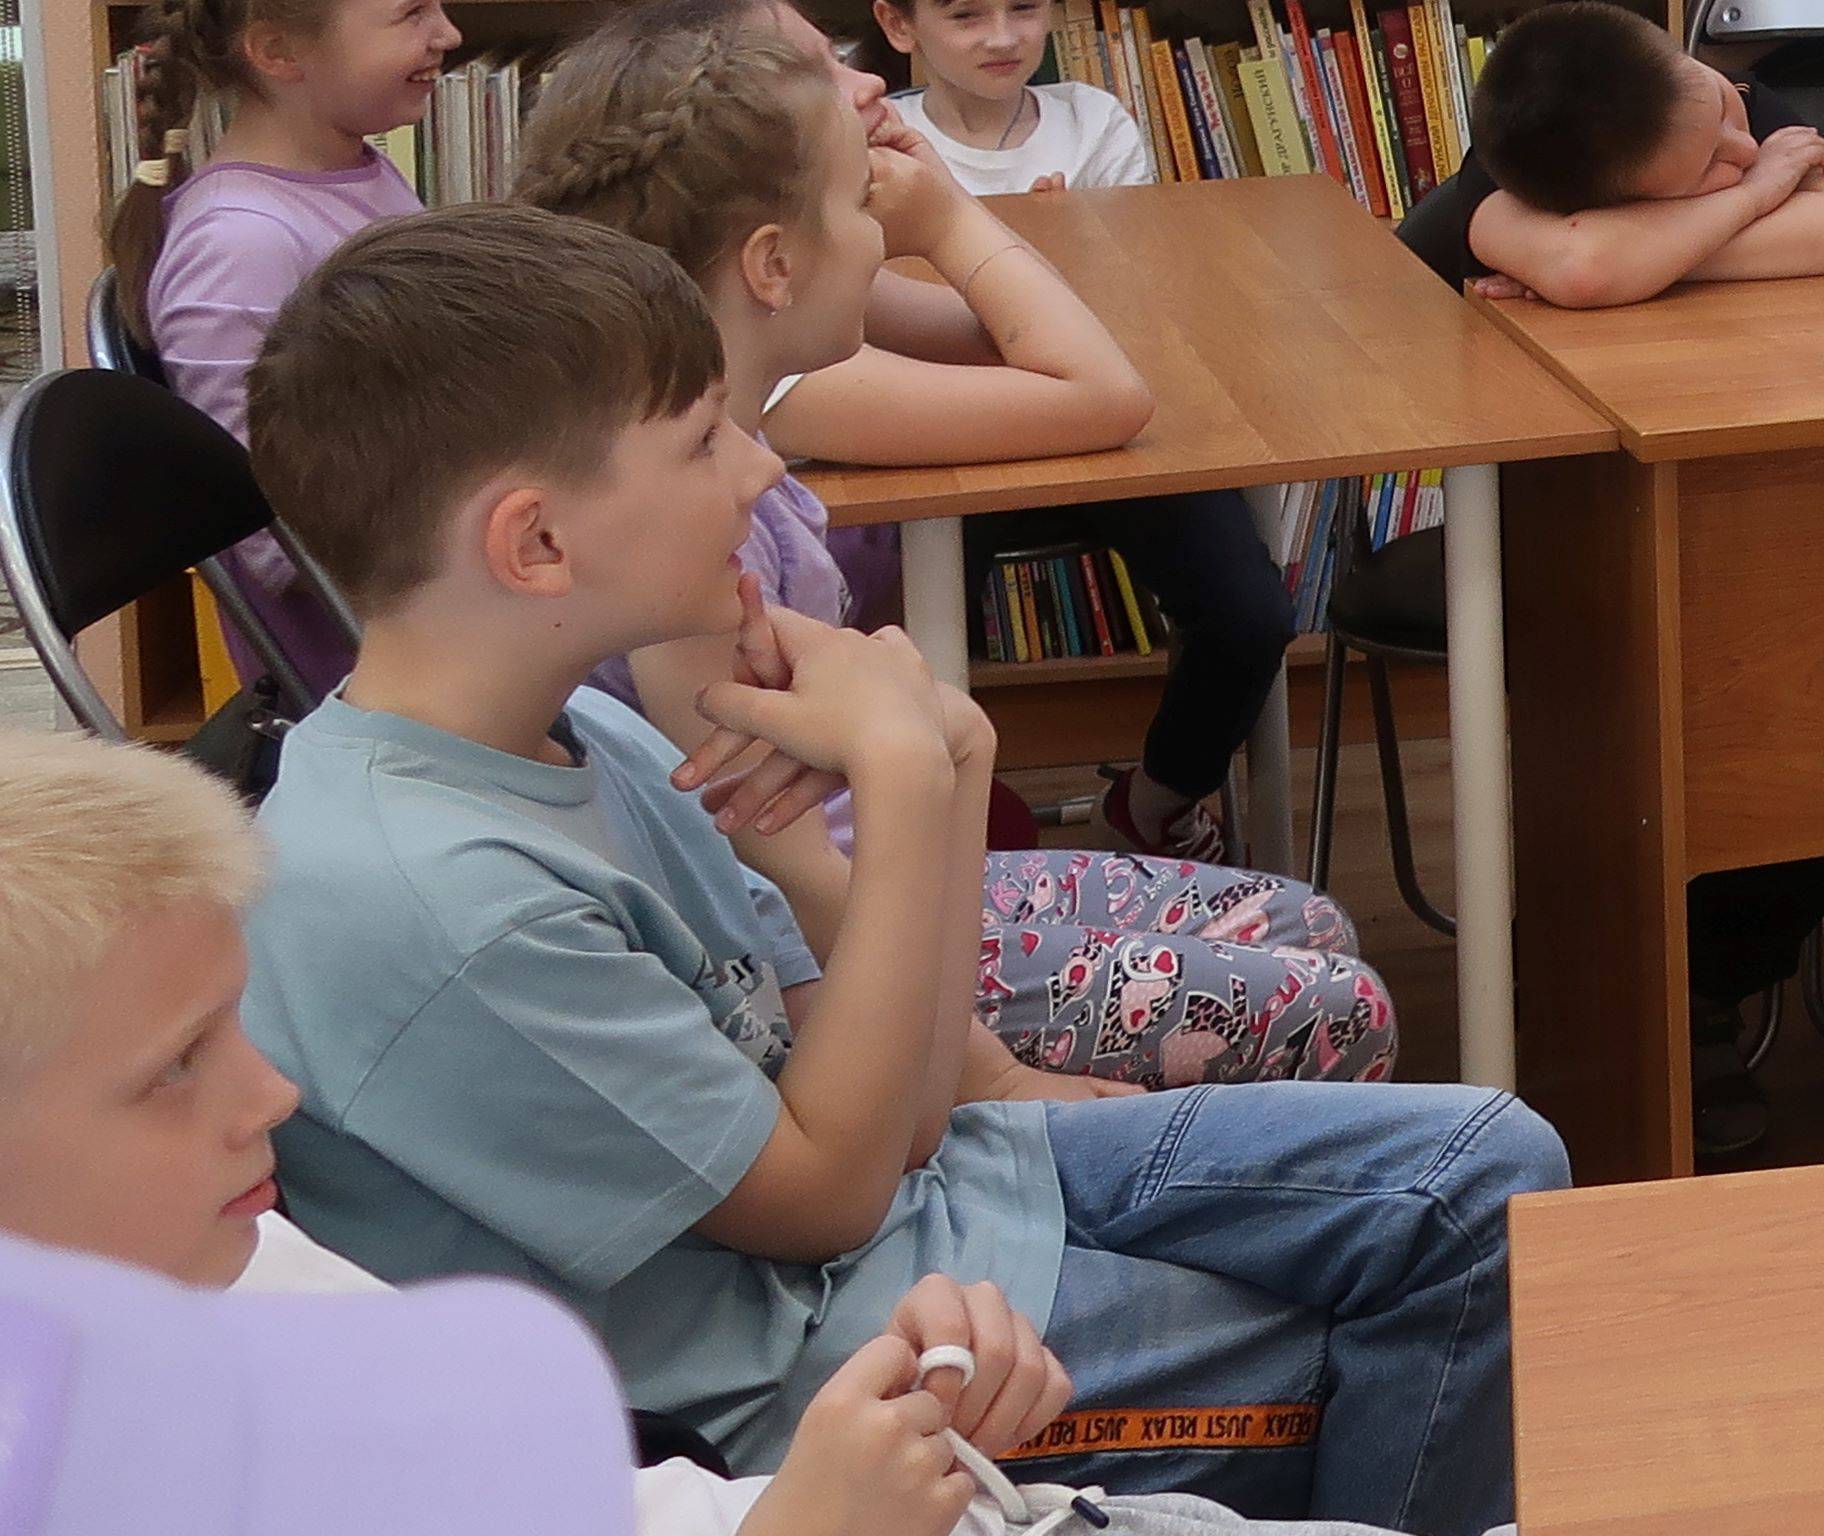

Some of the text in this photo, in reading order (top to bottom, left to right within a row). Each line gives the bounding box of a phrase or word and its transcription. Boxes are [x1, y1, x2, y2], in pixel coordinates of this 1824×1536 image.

[1433, 125, 1447, 180] РАГУНСКИЙ
[1082, 1415, 1128, 1444] JUST
[1140, 1414, 1197, 1440] RELAX
[1204, 1414, 1254, 1438] JUST
